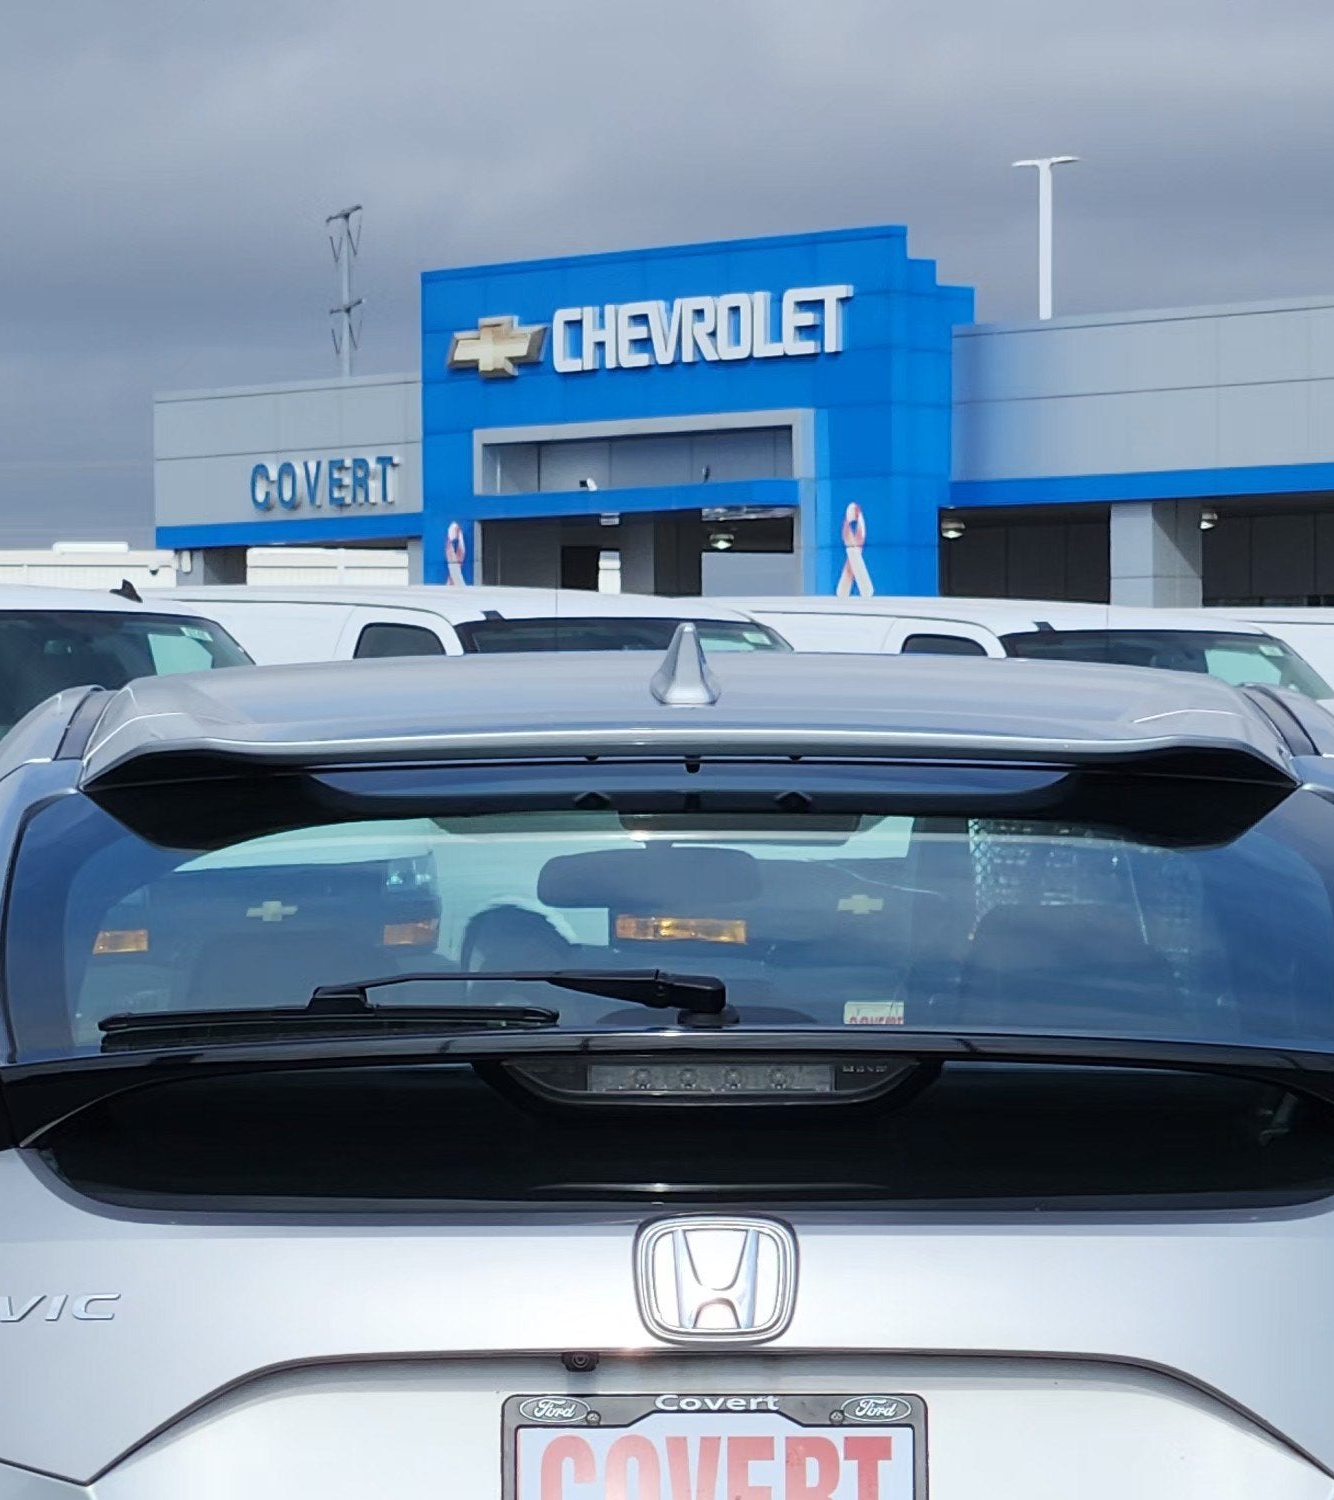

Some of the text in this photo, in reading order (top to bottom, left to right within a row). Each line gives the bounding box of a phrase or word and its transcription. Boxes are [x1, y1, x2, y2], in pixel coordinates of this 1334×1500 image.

[553, 285, 854, 373] CHEVROLET
[250, 456, 395, 512] COVERT
[533, 1399, 577, 1418] Ford
[654, 1394, 780, 1412] Covert
[855, 1399, 898, 1417] Ford
